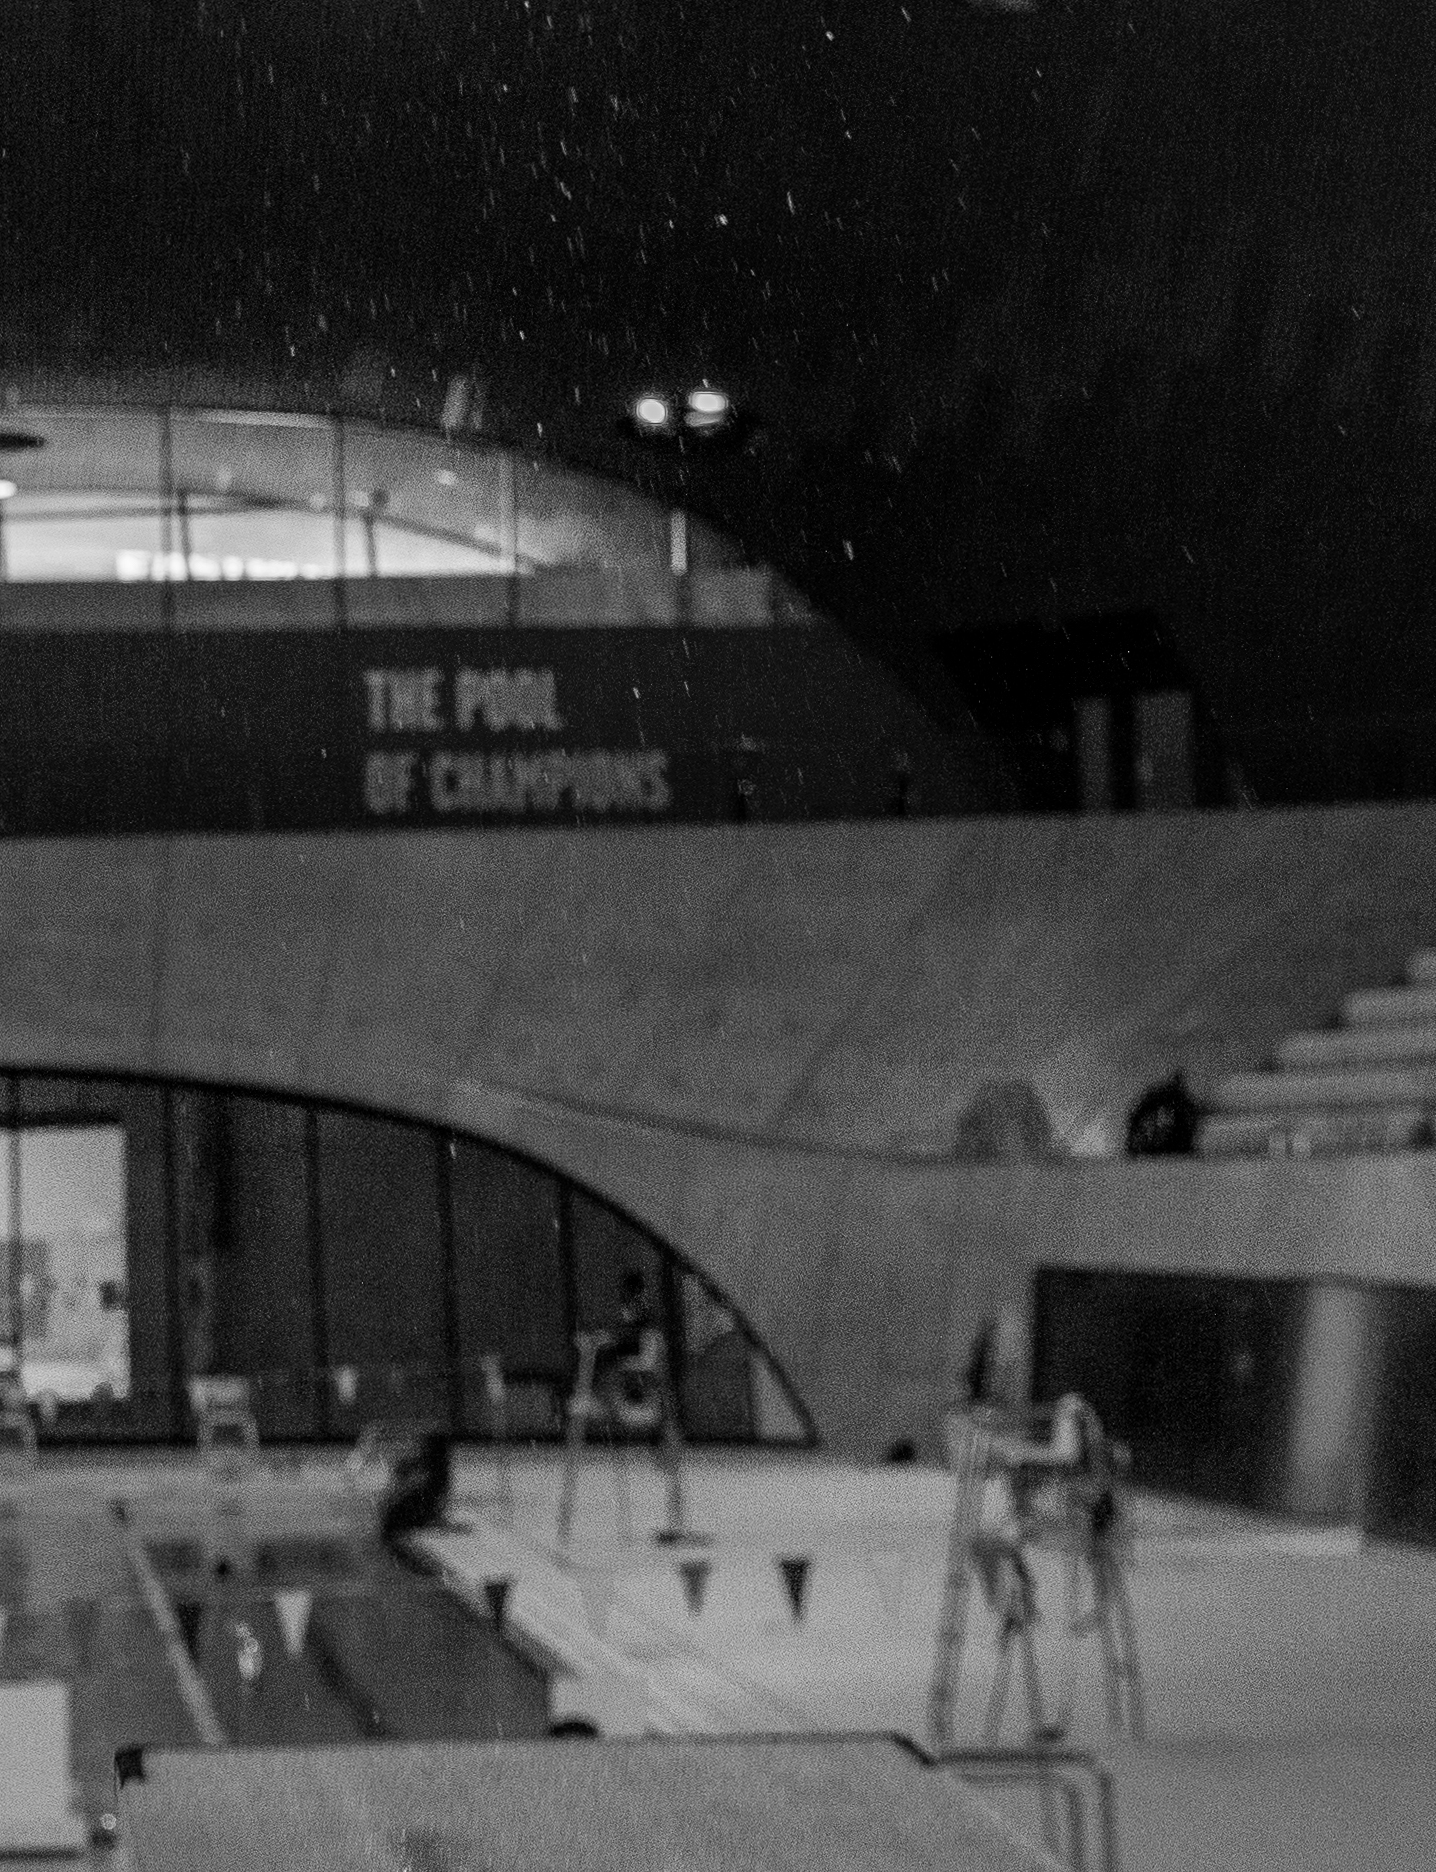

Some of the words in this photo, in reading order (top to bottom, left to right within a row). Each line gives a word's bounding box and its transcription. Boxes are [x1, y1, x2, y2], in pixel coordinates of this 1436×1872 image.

[363, 666, 443, 732] THE
[455, 666, 562, 732] POOL
[363, 750, 417, 814] OF
[430, 749, 670, 813] CHAMPIONS
